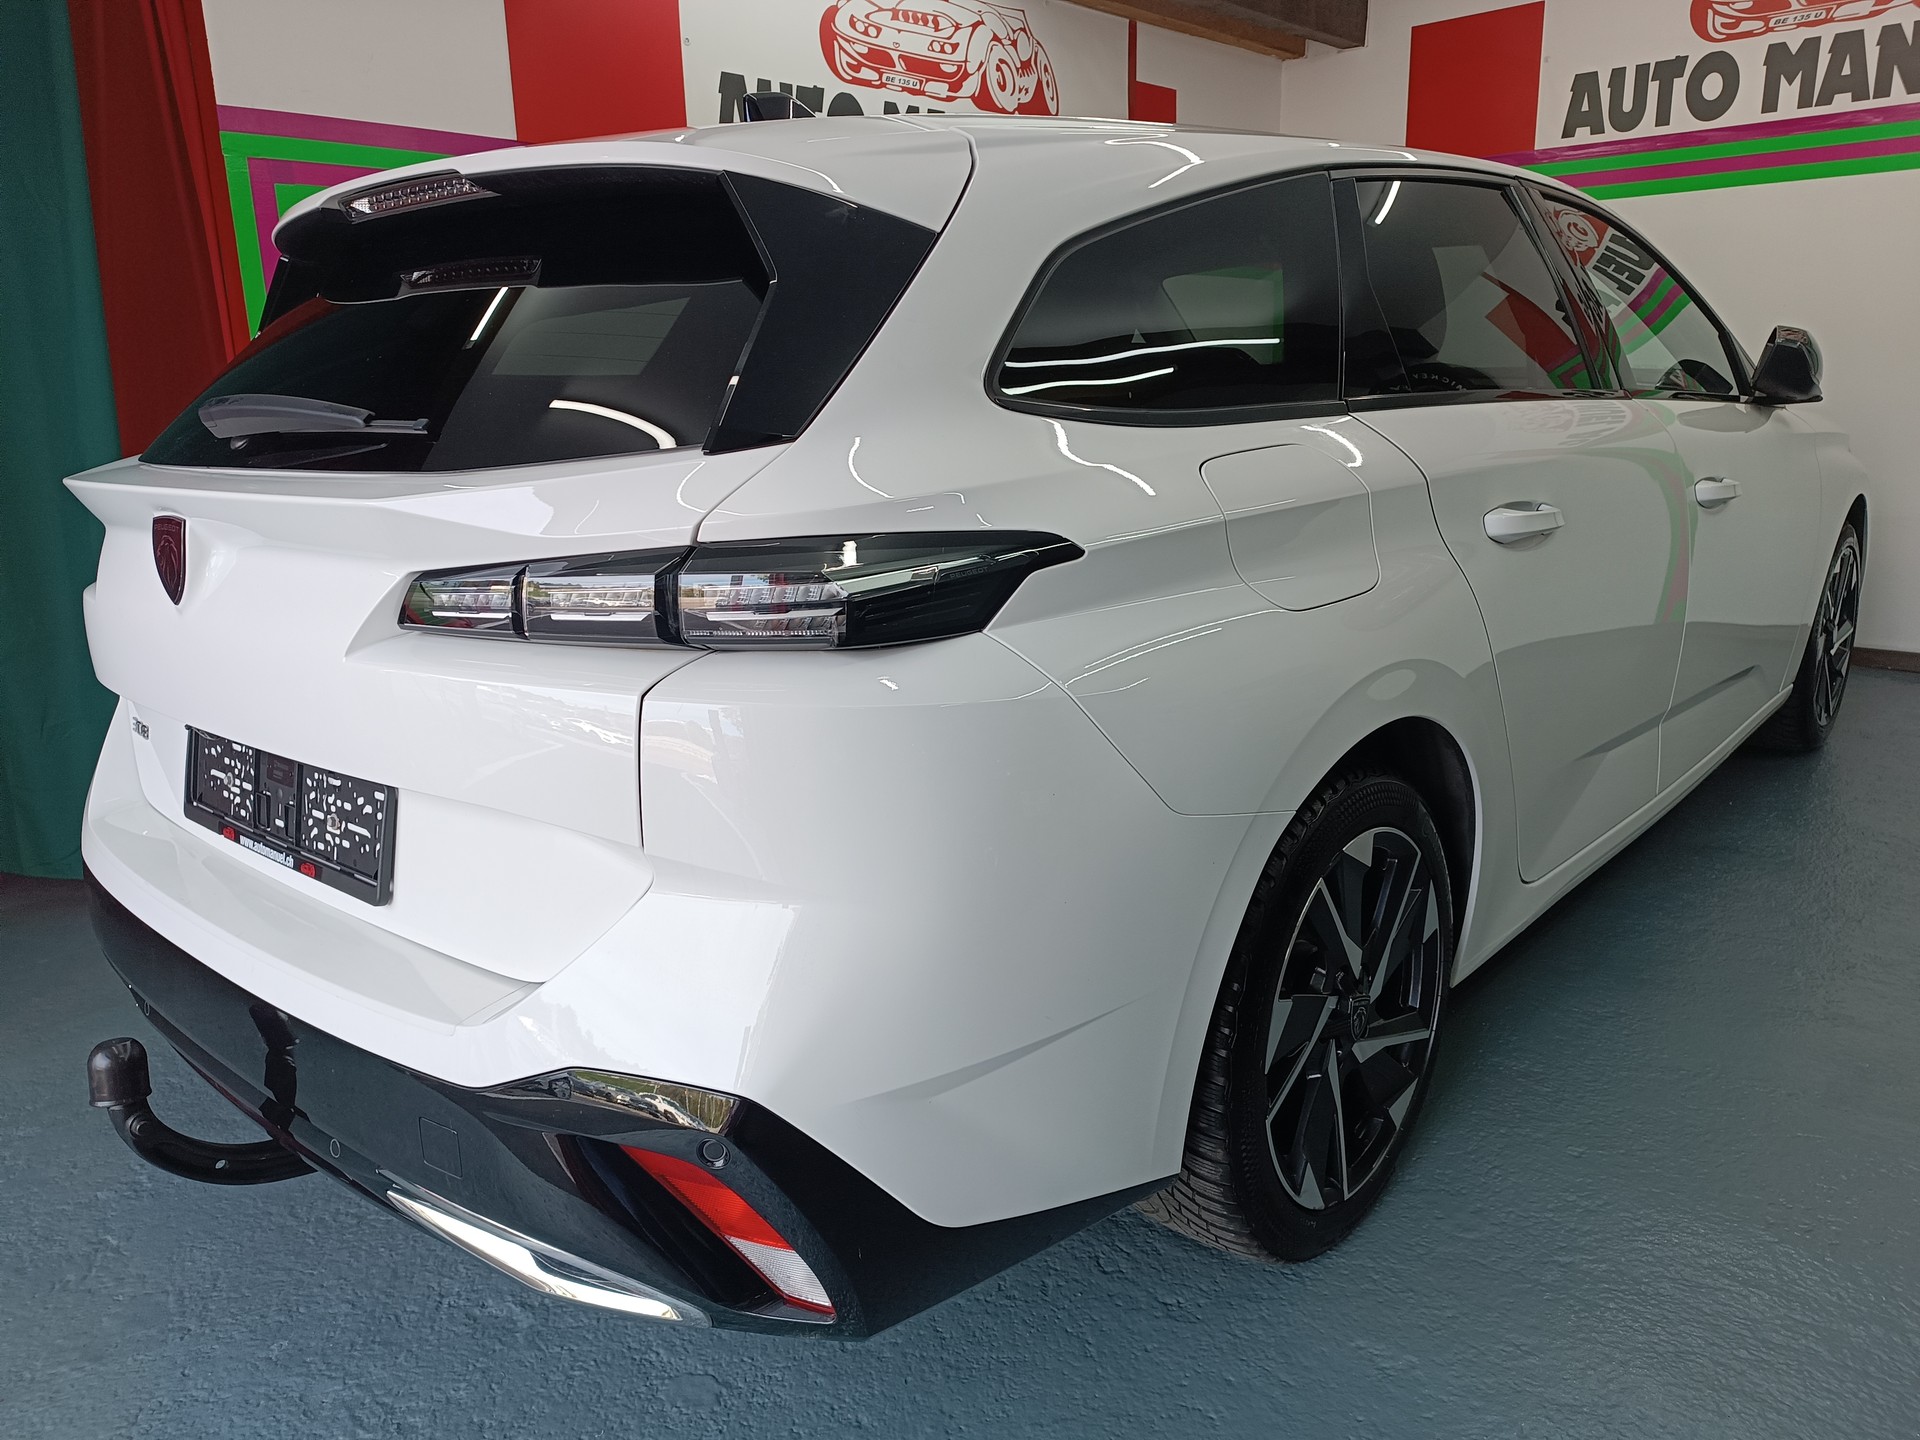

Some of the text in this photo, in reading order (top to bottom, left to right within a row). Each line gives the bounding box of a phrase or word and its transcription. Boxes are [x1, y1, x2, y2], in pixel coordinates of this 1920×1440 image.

[1773, 17, 1789, 26] BE
[1792, 13, 1812, 22] 135
[885, 75, 896, 83] BE
[898, 78, 911, 86] 135
[1561, 20, 1920, 139] AUTO MAN
[154, 523, 180, 532] PEUGEOT
[950, 566, 988, 579] PEUGEOT
[239, 834, 294, 869] www.automanuel.ch
